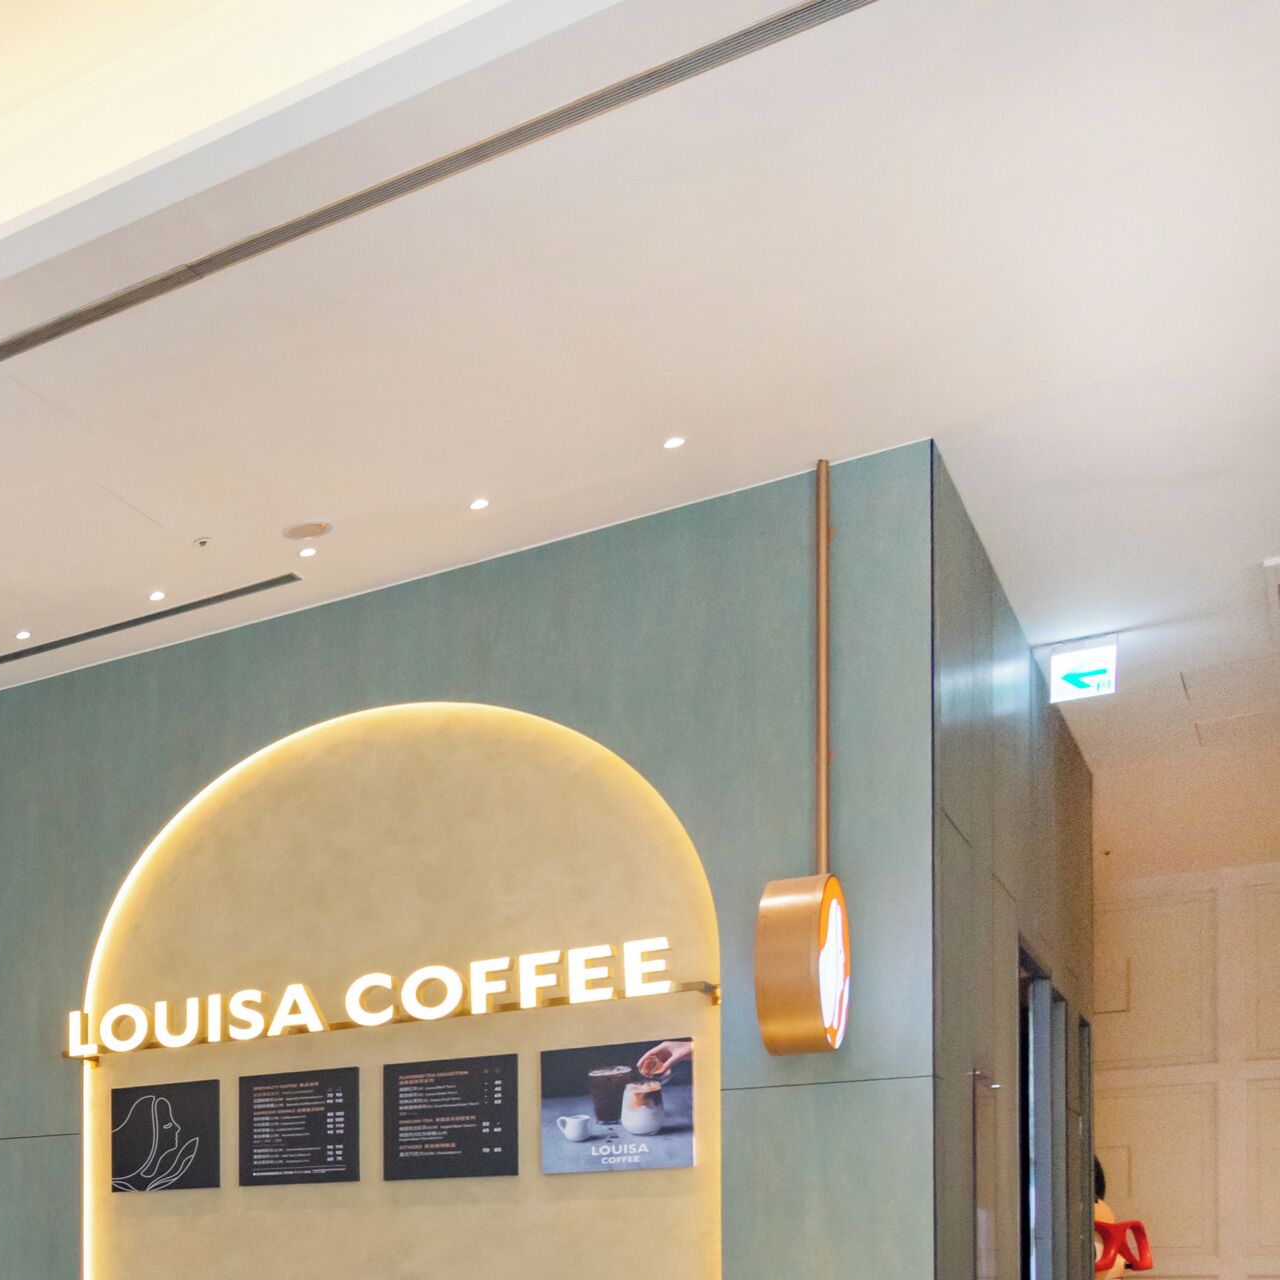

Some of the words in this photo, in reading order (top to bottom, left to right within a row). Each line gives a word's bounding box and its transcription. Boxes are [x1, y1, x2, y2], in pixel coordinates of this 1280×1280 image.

[68, 983, 325, 1057] LOUISA
[344, 936, 673, 1027] COFFEE
[591, 1143, 650, 1156] LOUISA
[601, 1155, 640, 1165] COFFEE
